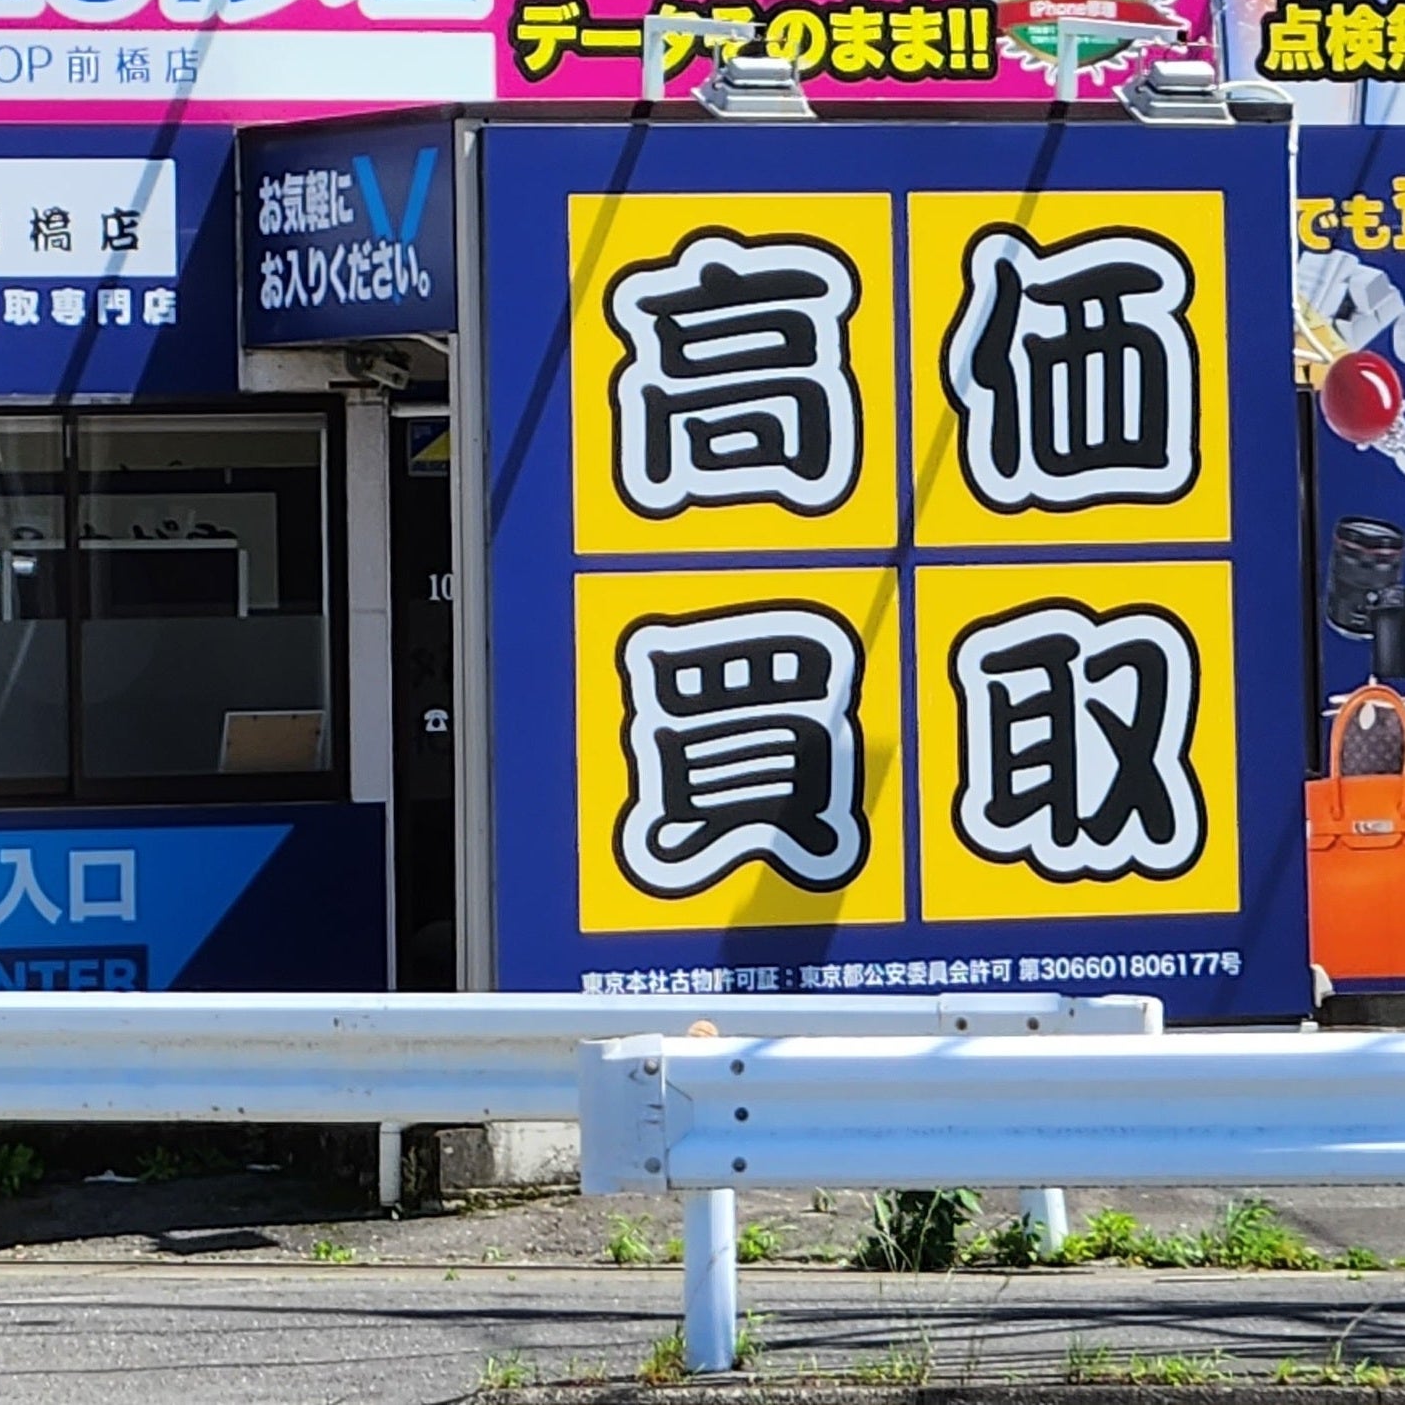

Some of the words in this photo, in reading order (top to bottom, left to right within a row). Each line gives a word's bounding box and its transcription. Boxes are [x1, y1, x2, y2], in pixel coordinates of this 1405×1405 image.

[67, 46, 199, 84] 前橋店
[259, 170, 354, 235] お気軽に
[1296, 176, 1405, 250] でも
[261, 239, 431, 310] お入りください。
[624, 242, 1182, 502] 高価
[639, 624, 1186, 874] 買取
